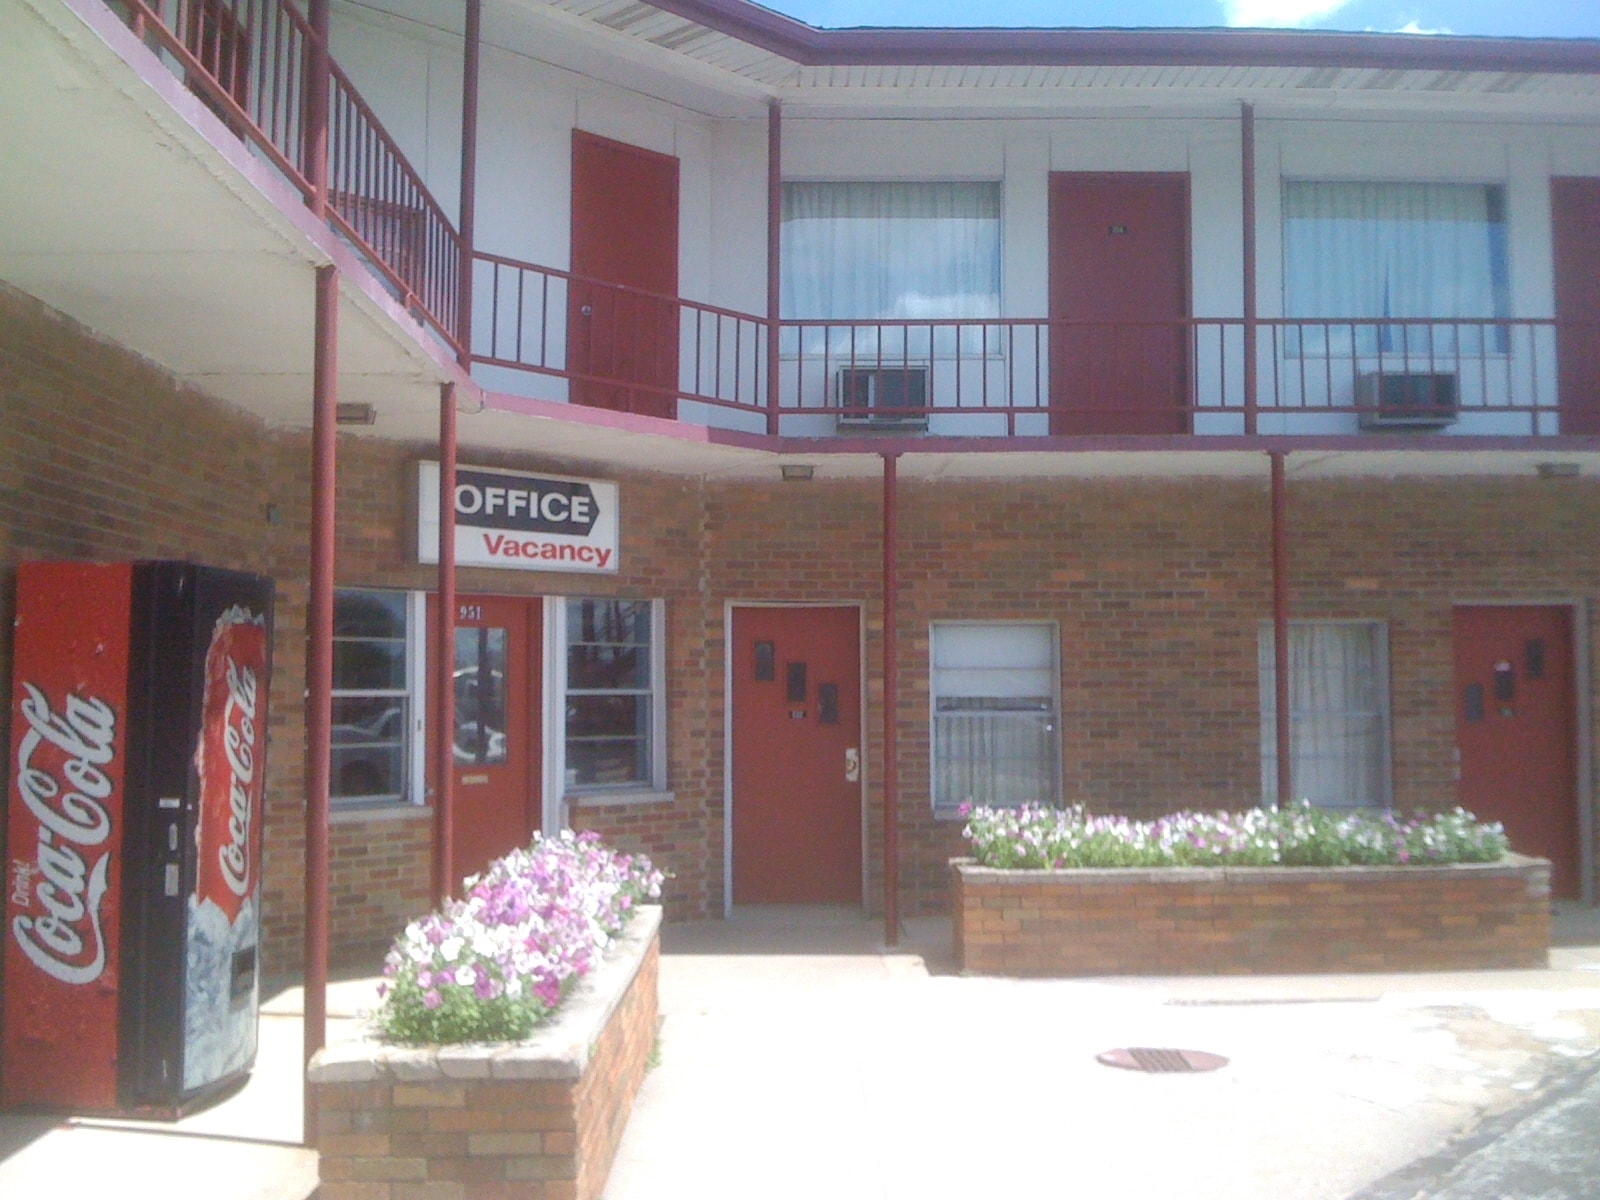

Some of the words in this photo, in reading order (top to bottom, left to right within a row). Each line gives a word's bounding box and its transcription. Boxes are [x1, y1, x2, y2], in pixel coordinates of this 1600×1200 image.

[455, 484, 590, 523] OFFICE
[483, 533, 612, 568] Vacancy
[13, 681, 115, 985] Coca-Cola
[219, 655, 257, 896] Coca-Cola
